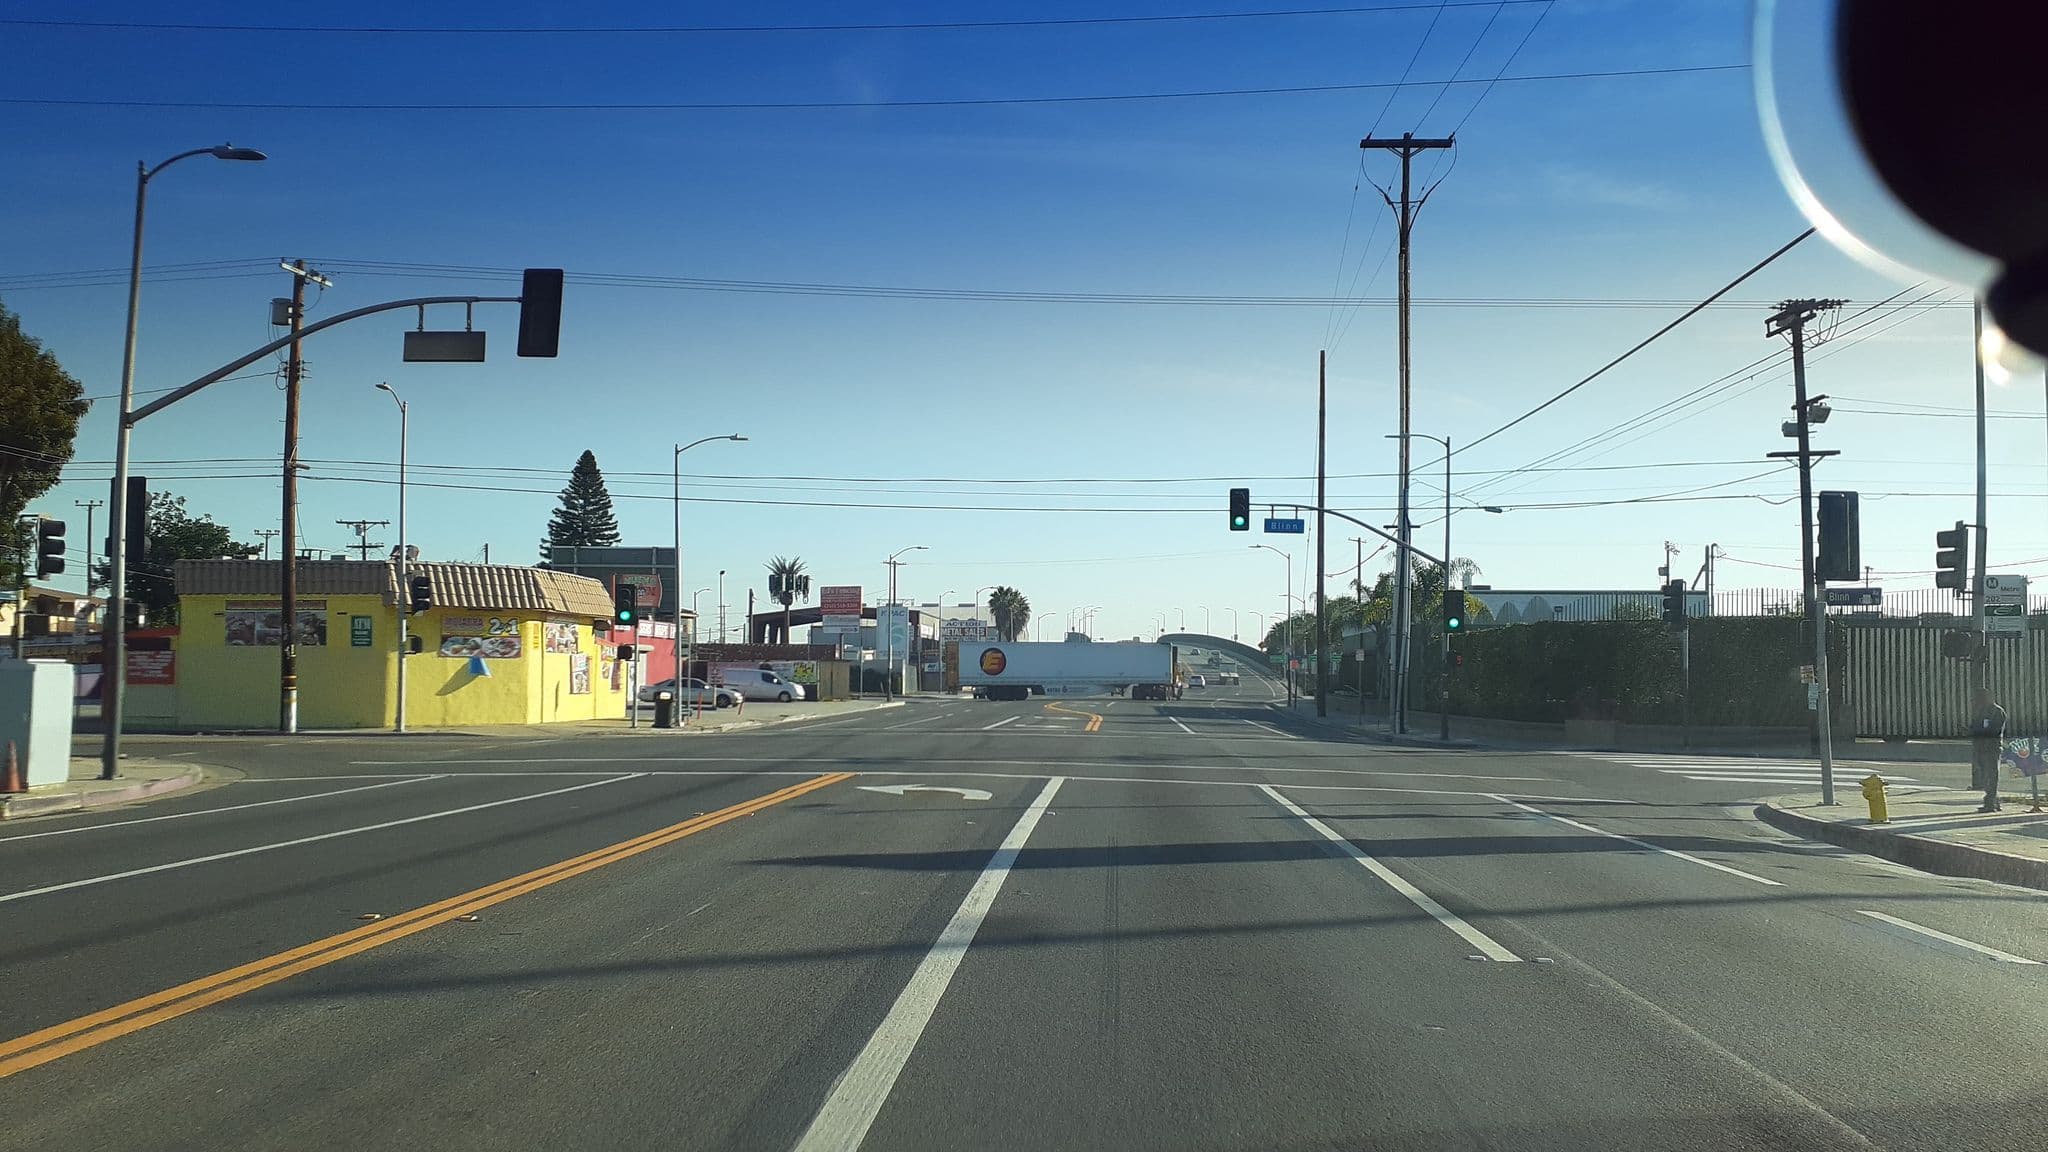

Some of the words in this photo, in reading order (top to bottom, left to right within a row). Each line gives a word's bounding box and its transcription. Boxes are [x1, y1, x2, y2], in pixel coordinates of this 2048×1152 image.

[1271, 521, 1298, 530] Blinn
[1829, 592, 1850, 601] Blinn
[941, 628, 963, 636] METAL
[964, 628, 985, 636] SALES
